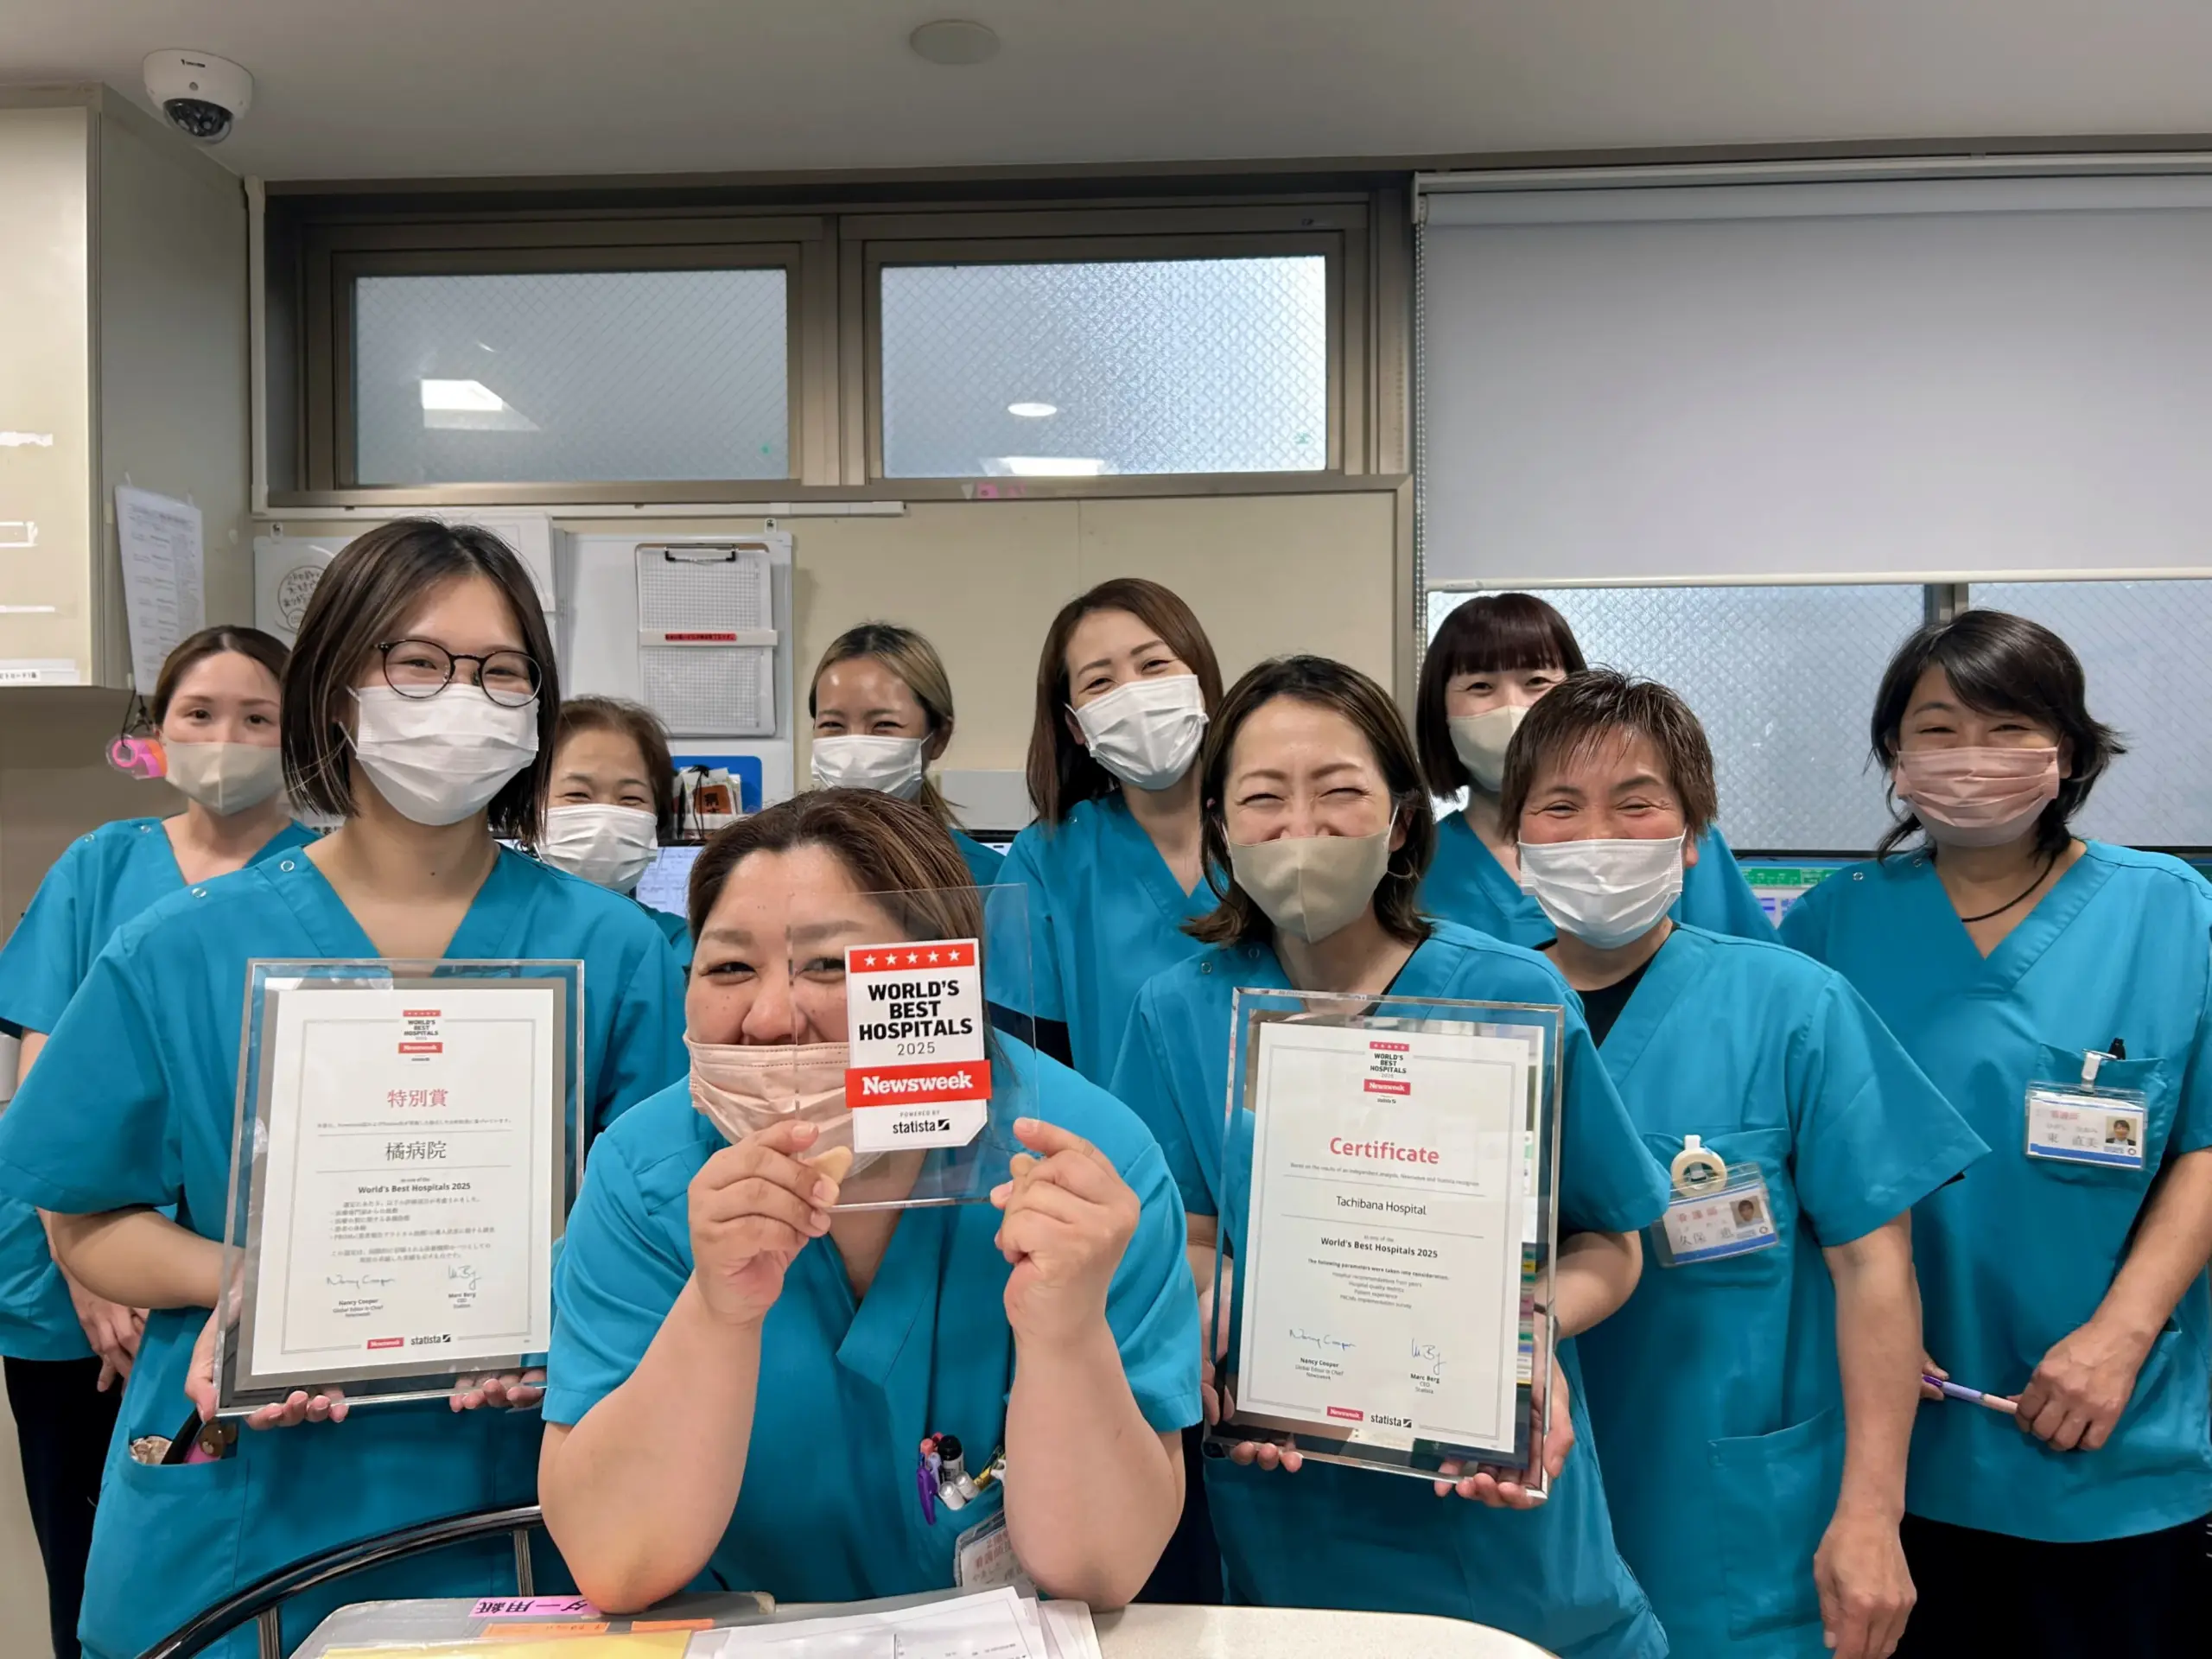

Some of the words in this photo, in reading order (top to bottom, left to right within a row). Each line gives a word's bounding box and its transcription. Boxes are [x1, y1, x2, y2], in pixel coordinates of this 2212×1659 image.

[868, 980, 960, 1001] WORLD'S
[889, 1001, 941, 1020] BEST
[859, 1018, 973, 1040] HOSPITALS
[897, 1042, 936, 1056] 2025
[861, 1071, 974, 1095] Newsweek
[387, 1089, 448, 1108] 特別賞
[893, 1120, 936, 1134] statista
[385, 1141, 447, 1161] 橘病院
[1330, 1137, 1440, 1164] Certificate
[358, 1185, 390, 1193] World's
[411, 1183, 449, 1192] Hospitals
[1337, 1196, 1383, 1211] Tachibana
[1386, 1202, 1427, 1216] Hospital
[1321, 1236, 1352, 1248] World's
[1354, 1241, 1372, 1250] Best
[1375, 1243, 1414, 1255] Hospitals
[1417, 1248, 1438, 1258] 2025
[410, 1336, 441, 1345] statista
[1427, 1376, 1440, 1384] Berg
[1370, 1414, 1402, 1427] statista
